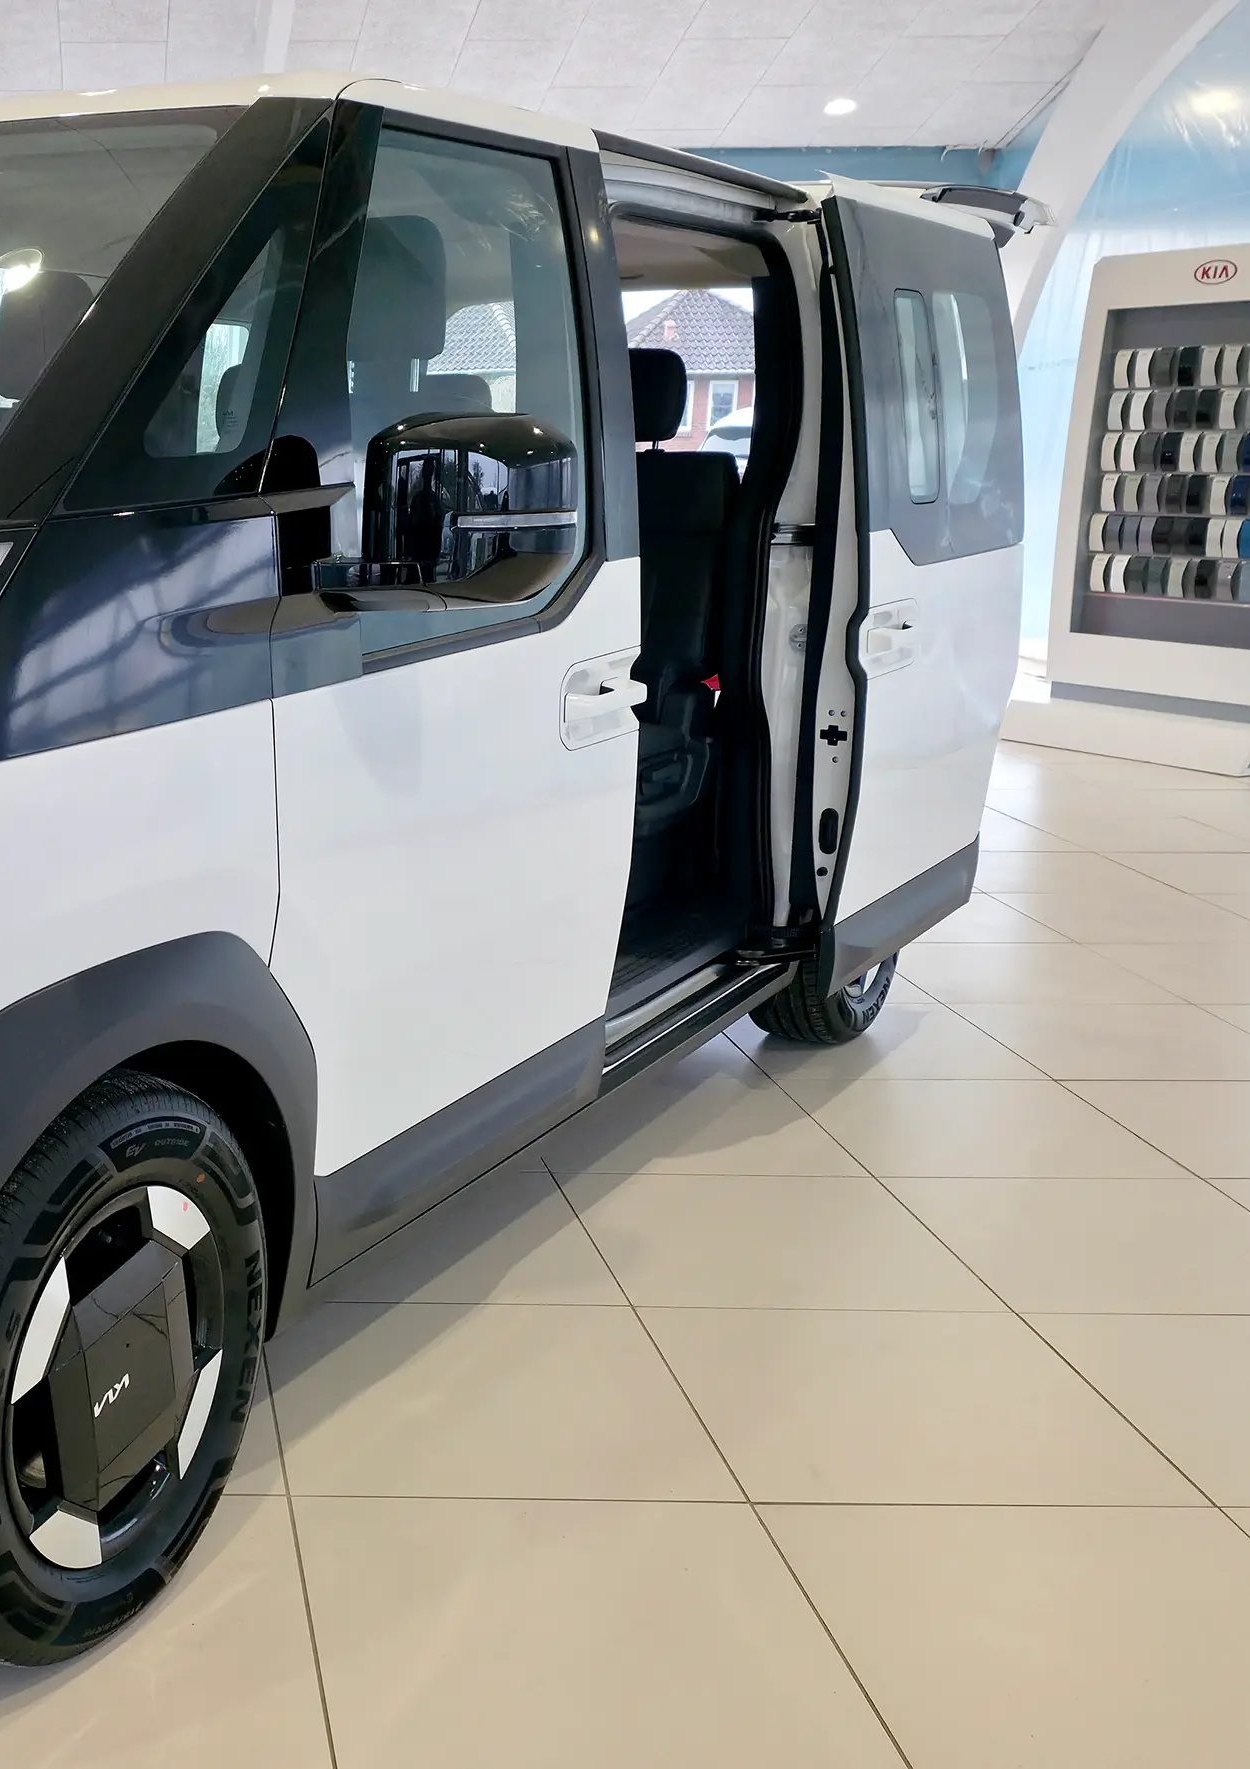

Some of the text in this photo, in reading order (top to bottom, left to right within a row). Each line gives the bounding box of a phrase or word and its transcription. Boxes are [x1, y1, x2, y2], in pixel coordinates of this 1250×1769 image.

[1201, 265, 1229, 280] KIA
[862, 976, 891, 1025] NEXEN
[230, 1250, 263, 1423] NEXEN
